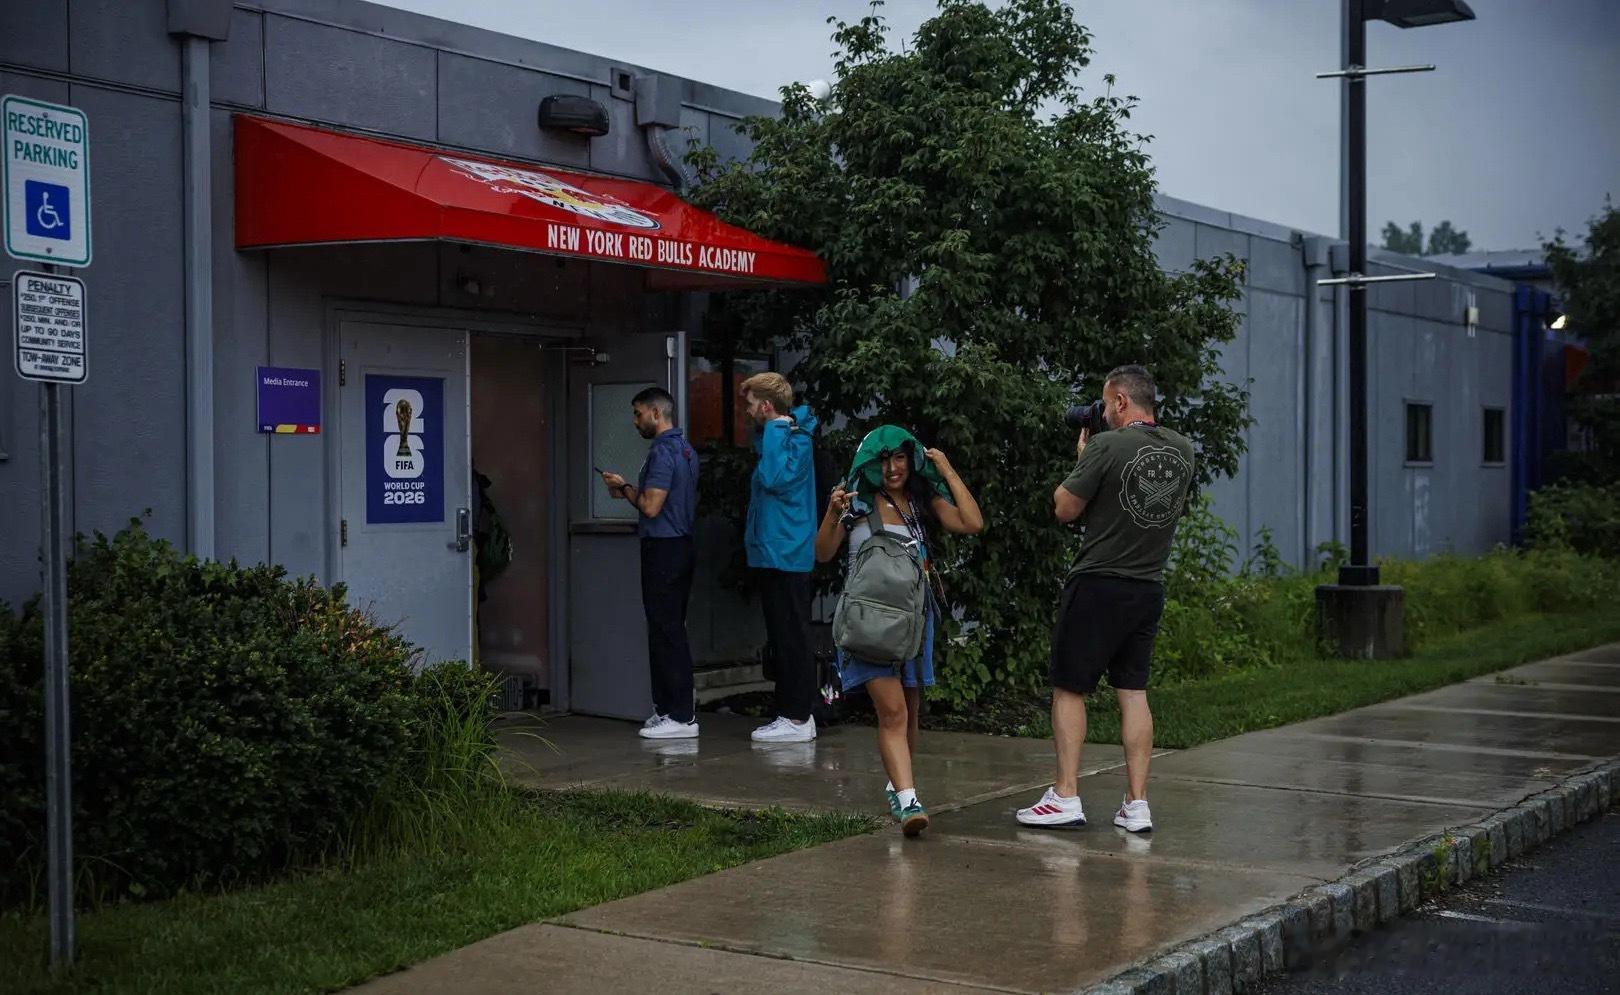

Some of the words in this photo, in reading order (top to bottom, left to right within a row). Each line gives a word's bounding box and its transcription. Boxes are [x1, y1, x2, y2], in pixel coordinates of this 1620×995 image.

[8, 112, 82, 144] RESERVED
[14, 140, 78, 170] PARKING
[547, 224, 580, 251] NEW
[586, 230, 623, 257] YORK
[629, 235, 653, 260] RED
[657, 239, 692, 265] BULLS
[699, 245, 756, 274] ACADEMY
[28, 280, 71, 294] PENALTY
[21, 325, 31, 333] UP
[34, 327, 45, 335] TO
[47, 328, 58, 337] 90
[61, 330, 81, 340] DAYS
[22, 352, 59, 364] TOW-AWAY
[62, 356, 81, 367] ZONE
[263, 377, 282, 386] Media
[283, 378, 309, 387] Entrance
[395, 460, 414, 470] FIFA
[384, 482, 410, 490] WORLD
[411, 482, 425, 490] CUP
[384, 491, 425, 505] 2026
